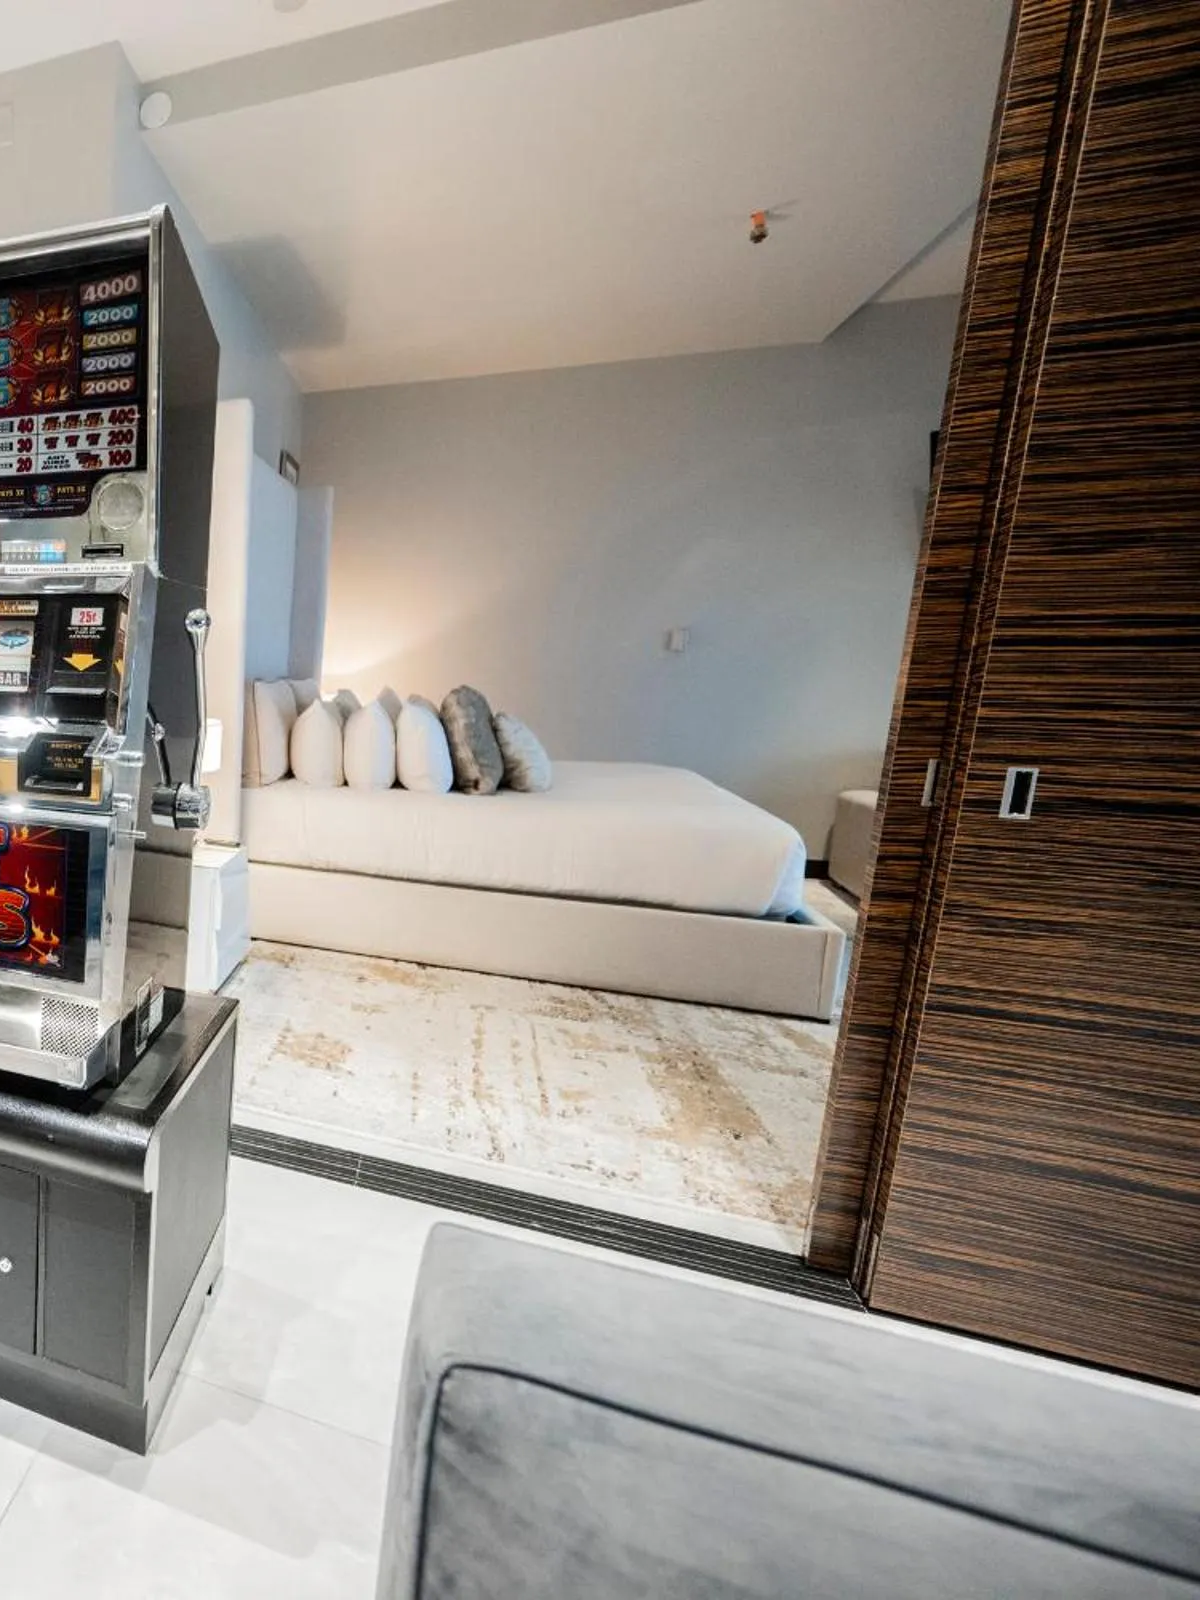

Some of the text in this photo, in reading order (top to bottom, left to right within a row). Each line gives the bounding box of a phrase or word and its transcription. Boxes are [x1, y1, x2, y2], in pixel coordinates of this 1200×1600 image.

[83, 275, 137, 302] 4000
[87, 306, 133, 326] 2000
[87, 331, 132, 349] 2000
[86, 353, 131, 372] 2000
[84, 379, 130, 395] 2000
[108, 408, 136, 425] 400
[17, 417, 34, 434] 40
[17, 438, 33, 453] 30
[107, 429, 134, 447] 200
[16, 457, 32, 473] 20
[108, 449, 132, 466] 100
